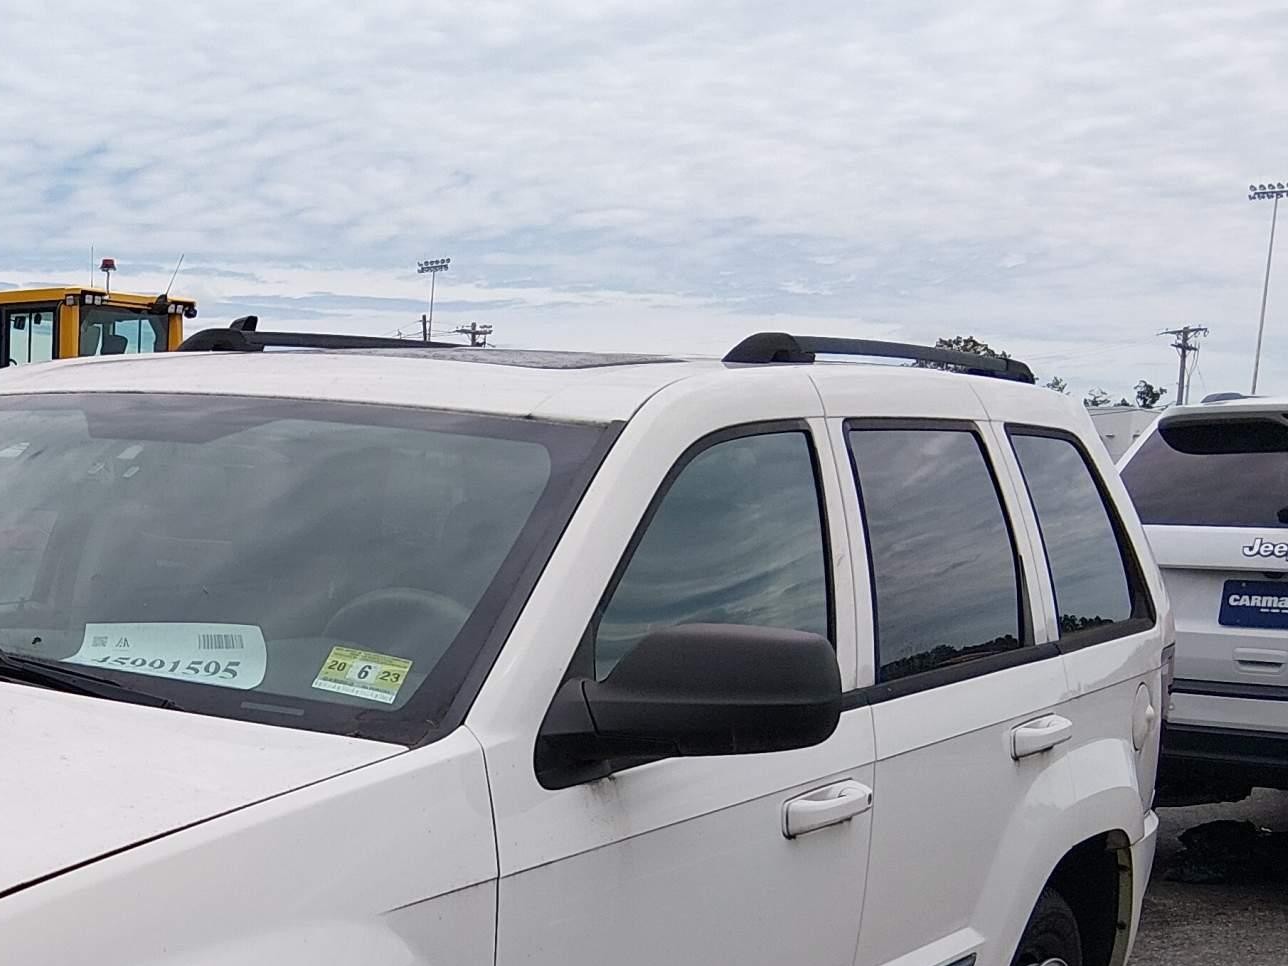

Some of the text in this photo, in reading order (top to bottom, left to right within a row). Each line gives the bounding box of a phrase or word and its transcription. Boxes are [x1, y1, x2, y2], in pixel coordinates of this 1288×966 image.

[328, 660, 401, 683] 20 6 23
